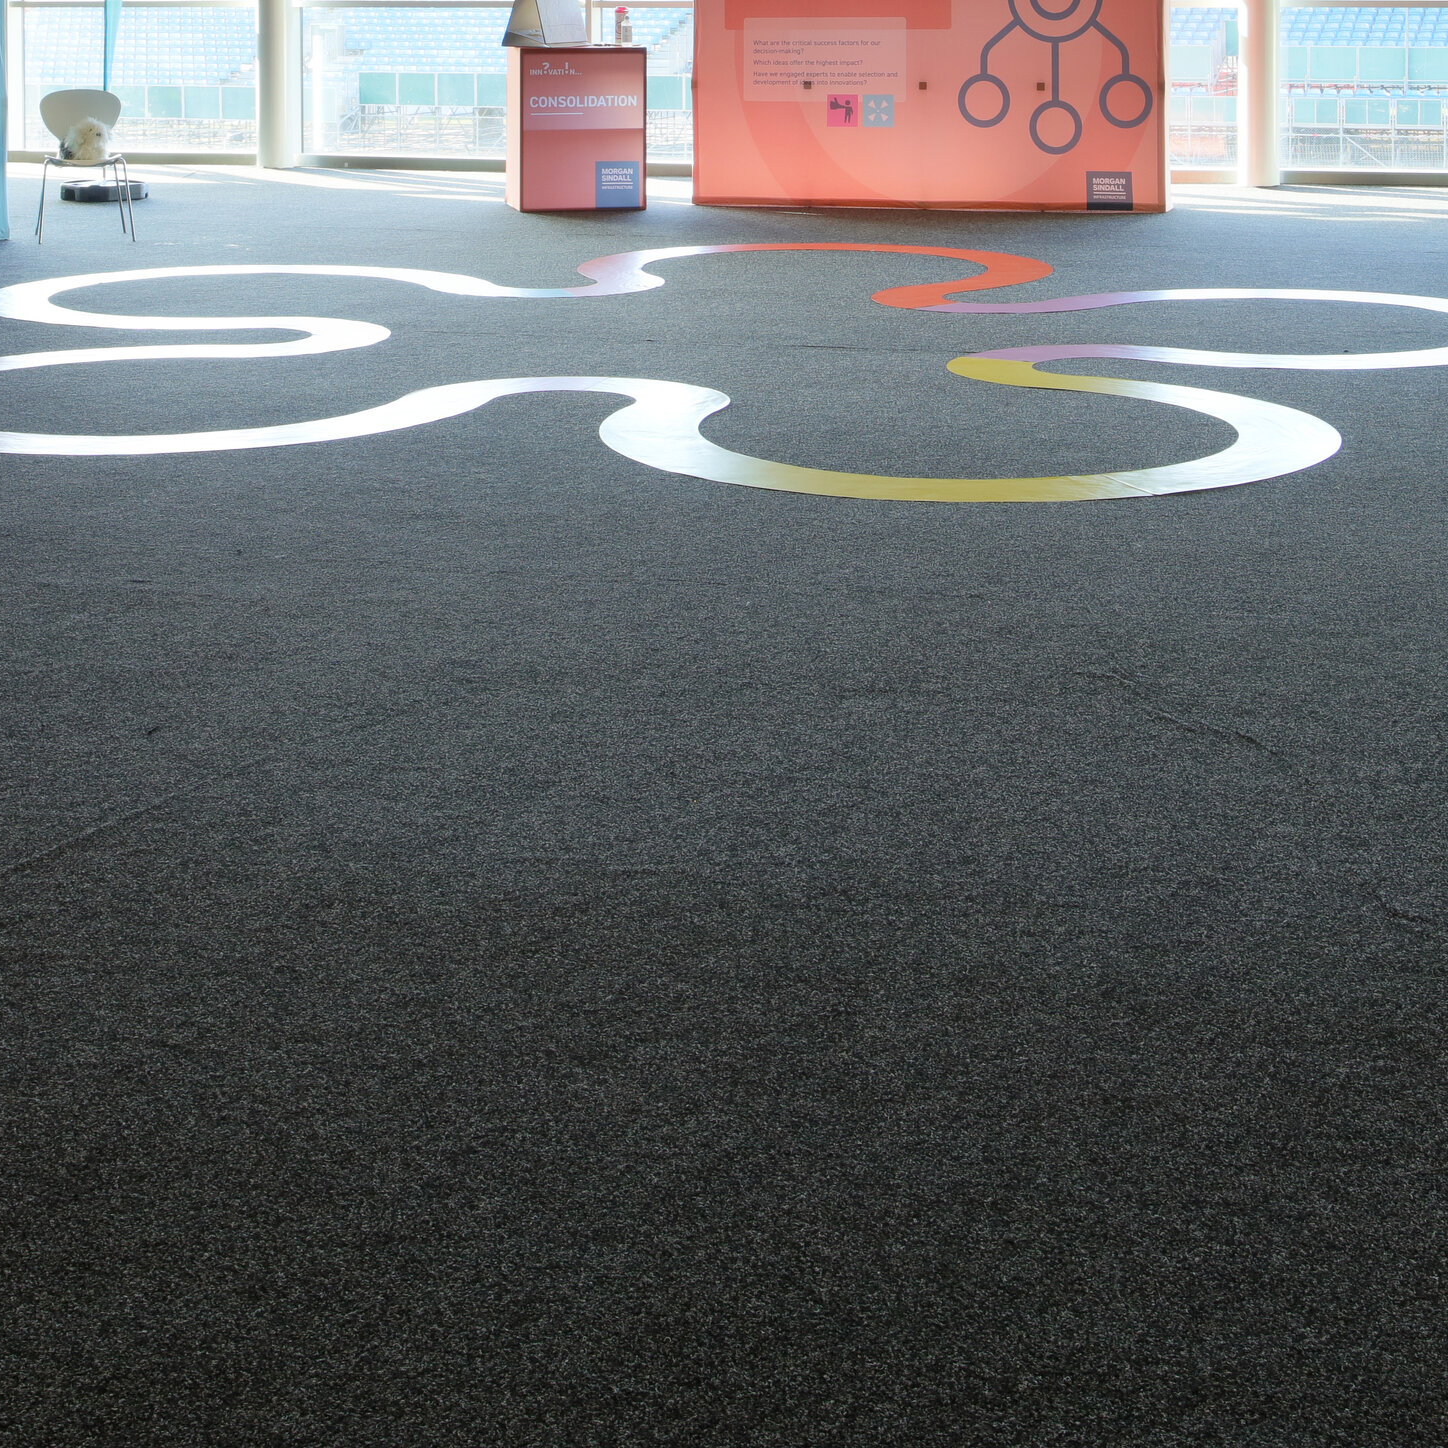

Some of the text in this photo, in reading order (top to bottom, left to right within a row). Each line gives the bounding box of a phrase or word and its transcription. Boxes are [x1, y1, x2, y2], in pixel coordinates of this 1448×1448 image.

[816, 59, 838, 67] highest
[840, 59, 863, 67] impact?
[529, 95, 638, 108] CONSOLIDATION
